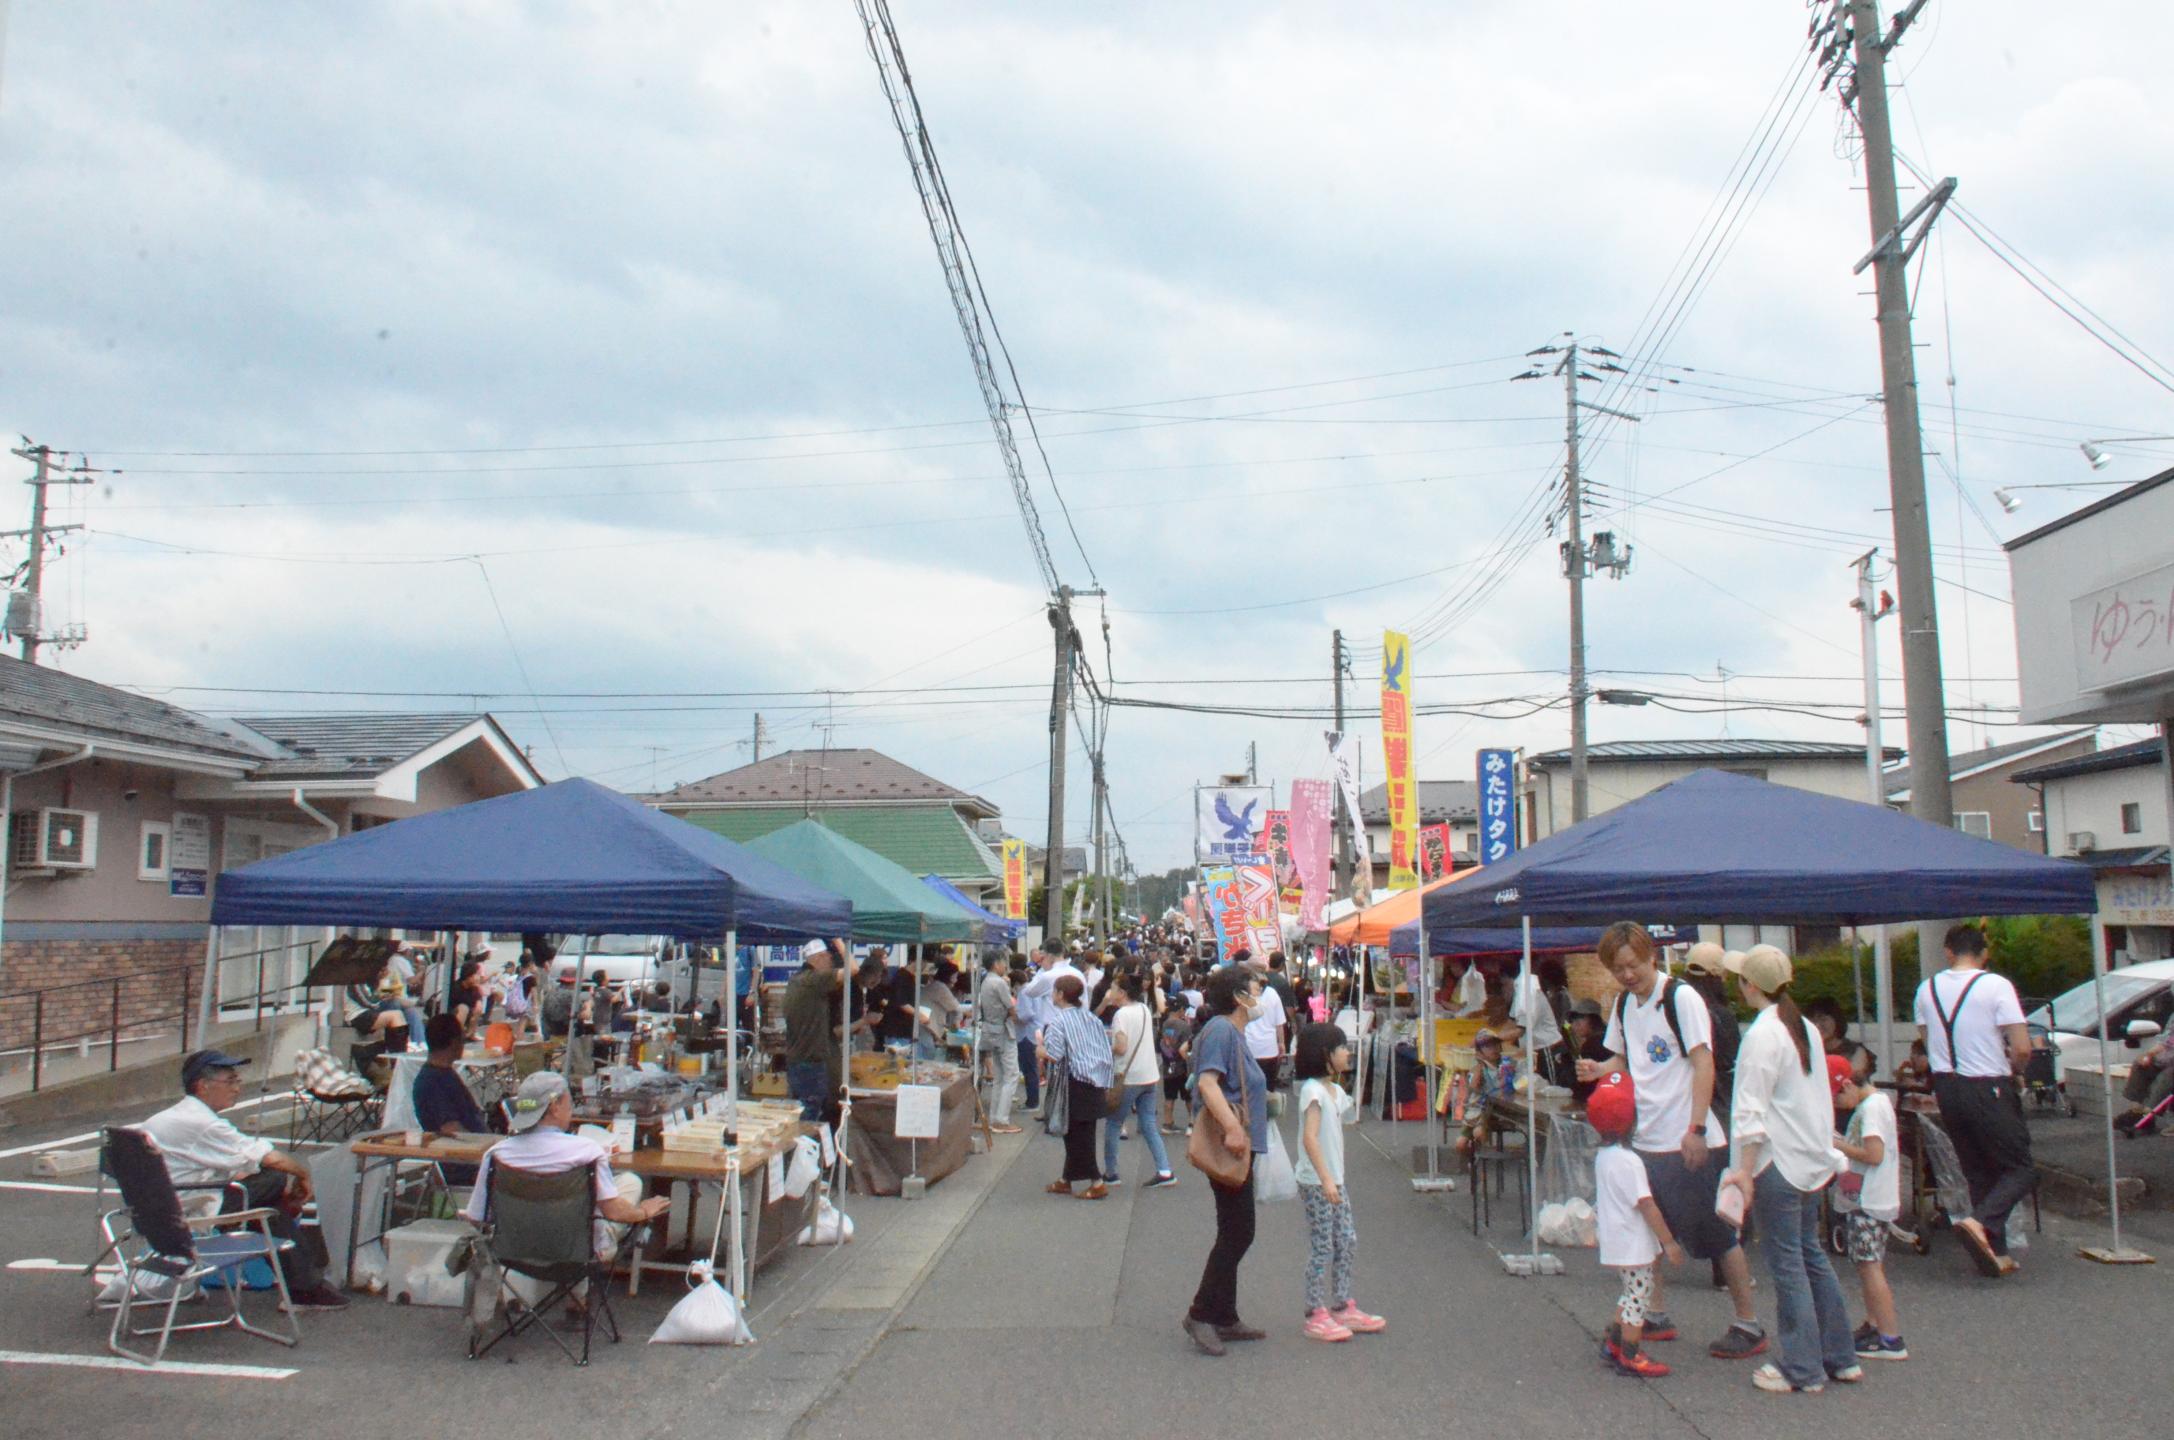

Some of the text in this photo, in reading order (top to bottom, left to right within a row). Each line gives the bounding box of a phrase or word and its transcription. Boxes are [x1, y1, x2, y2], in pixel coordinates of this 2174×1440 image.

[1486, 753, 1507, 860] みたけタク
